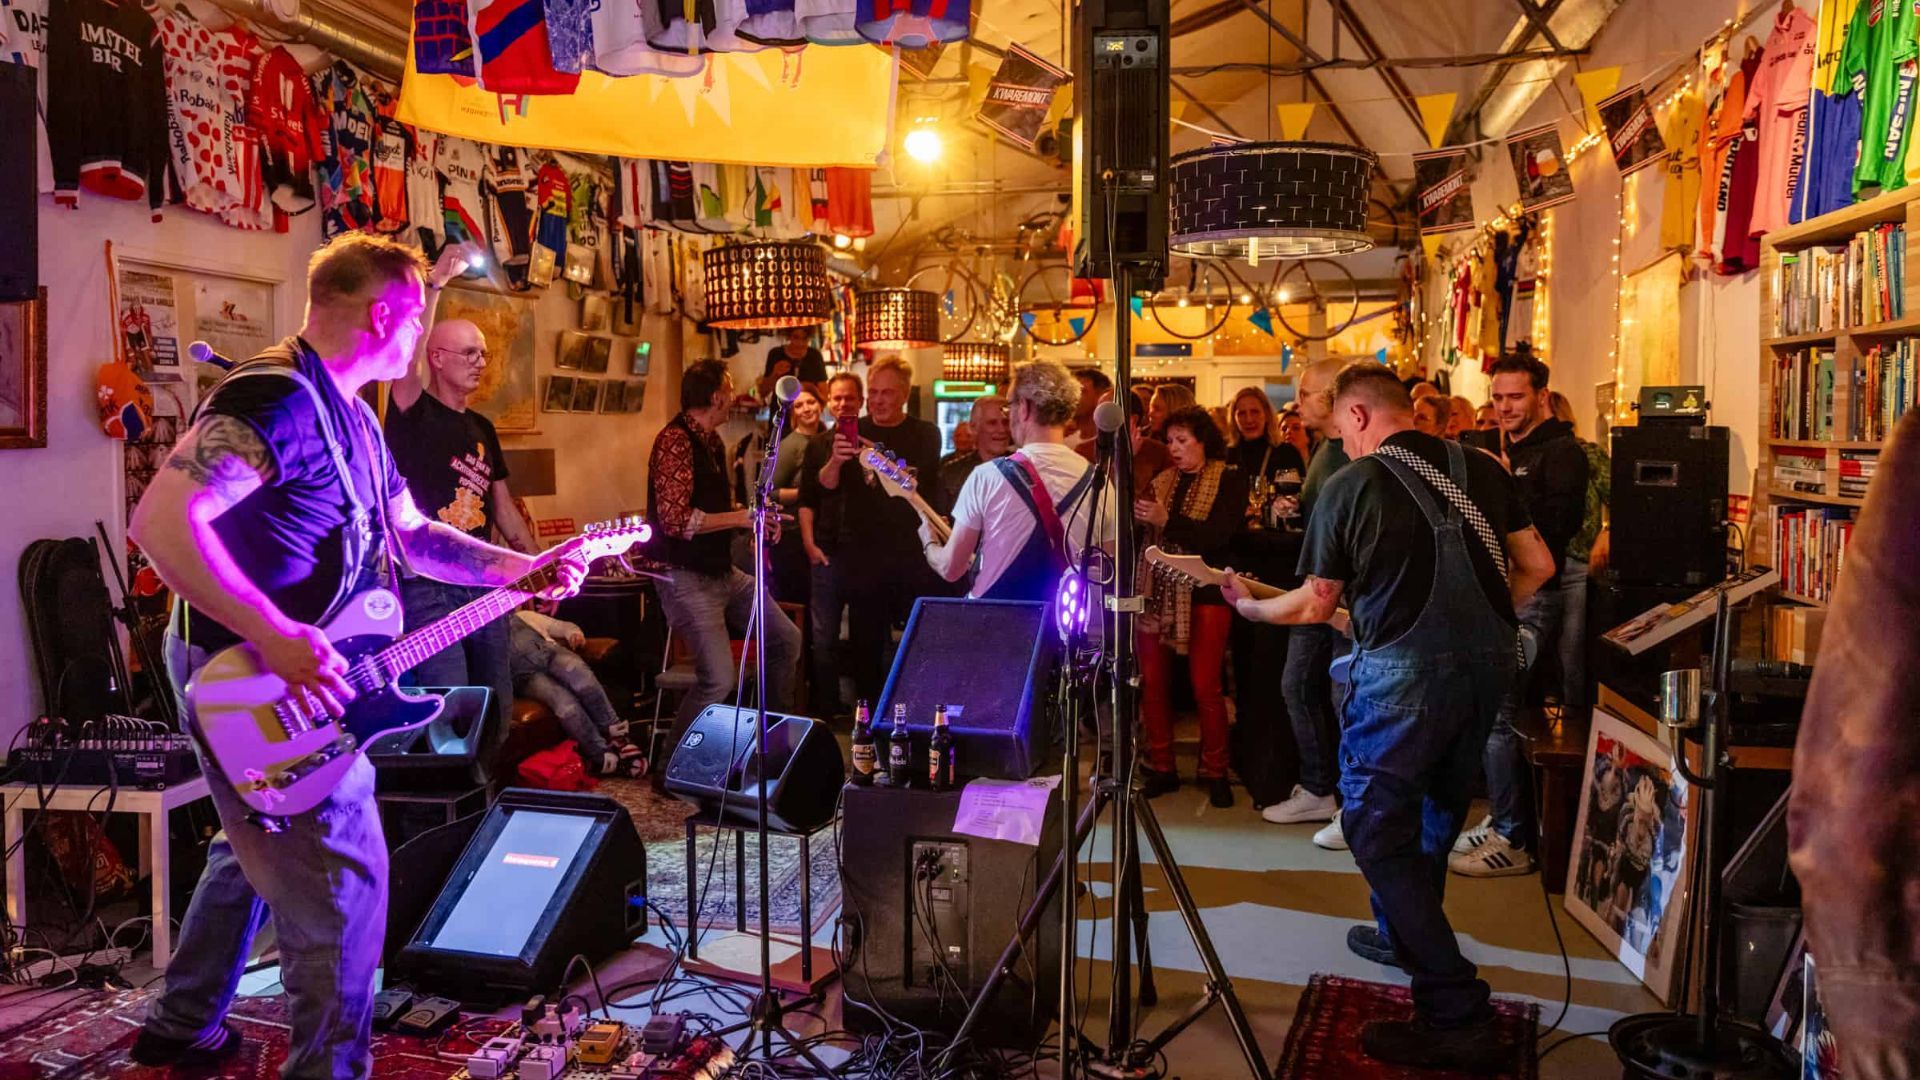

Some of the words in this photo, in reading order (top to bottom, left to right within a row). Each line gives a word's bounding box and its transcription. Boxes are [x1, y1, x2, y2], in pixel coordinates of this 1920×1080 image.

[993, 87, 1049, 105] KWAREMONT
[1614, 108, 1648, 152] KWAREMONT
[1423, 174, 1464, 210] KWAREMONT
